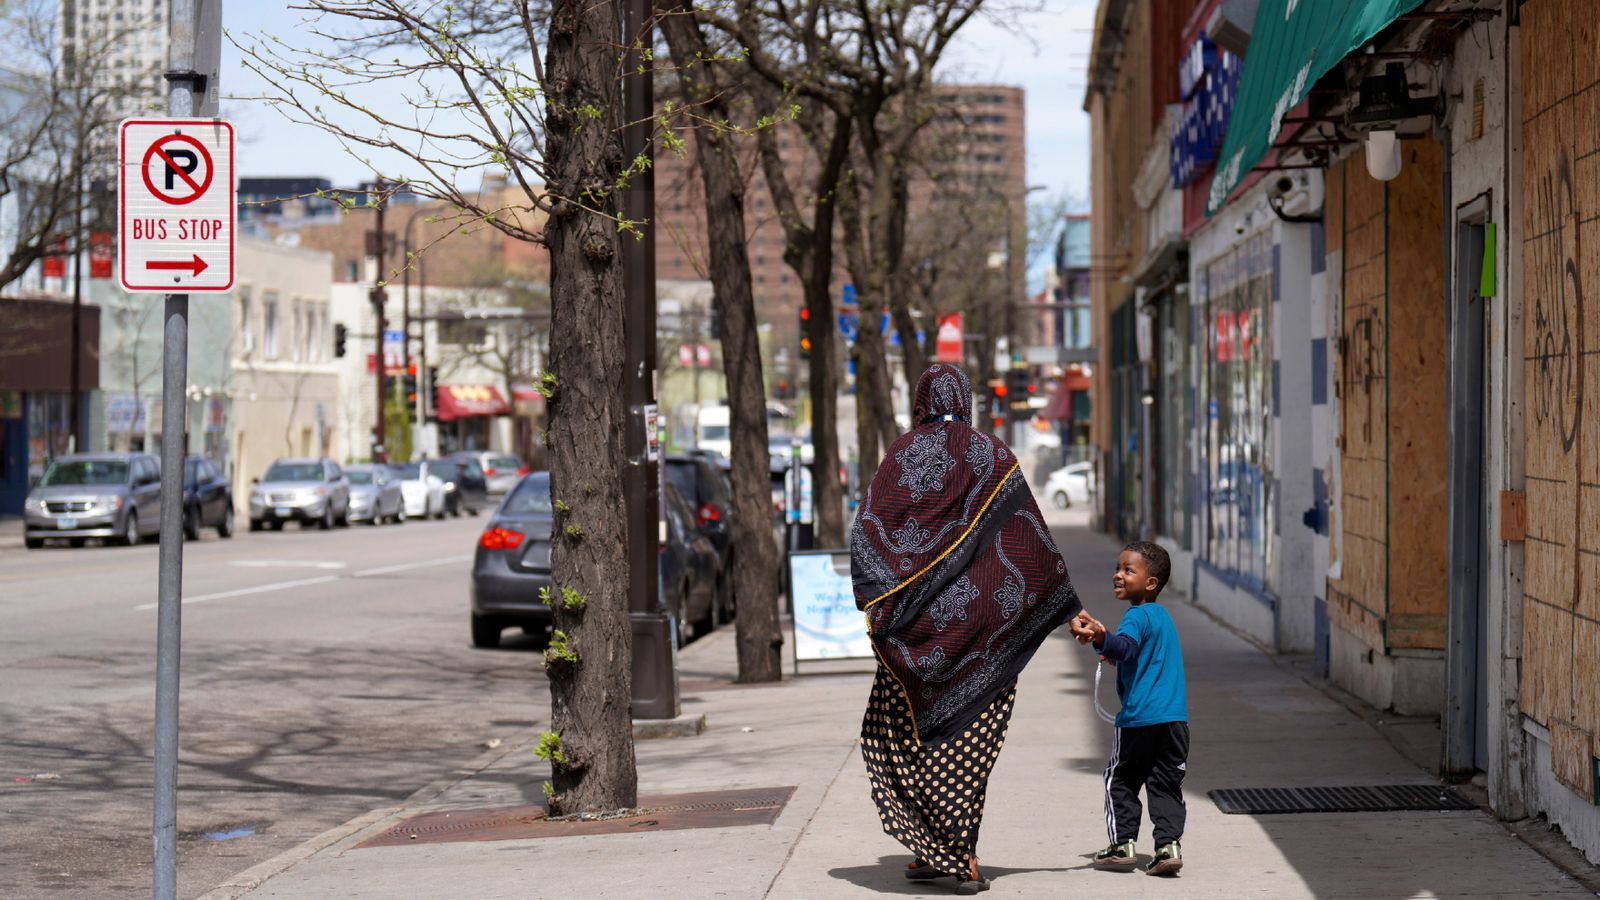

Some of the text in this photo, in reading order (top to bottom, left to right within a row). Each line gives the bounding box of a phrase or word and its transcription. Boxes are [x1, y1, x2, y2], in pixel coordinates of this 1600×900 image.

[165, 149, 198, 190] P
[133, 218, 222, 240] BUS STOP
[814, 593, 833, 602] We
